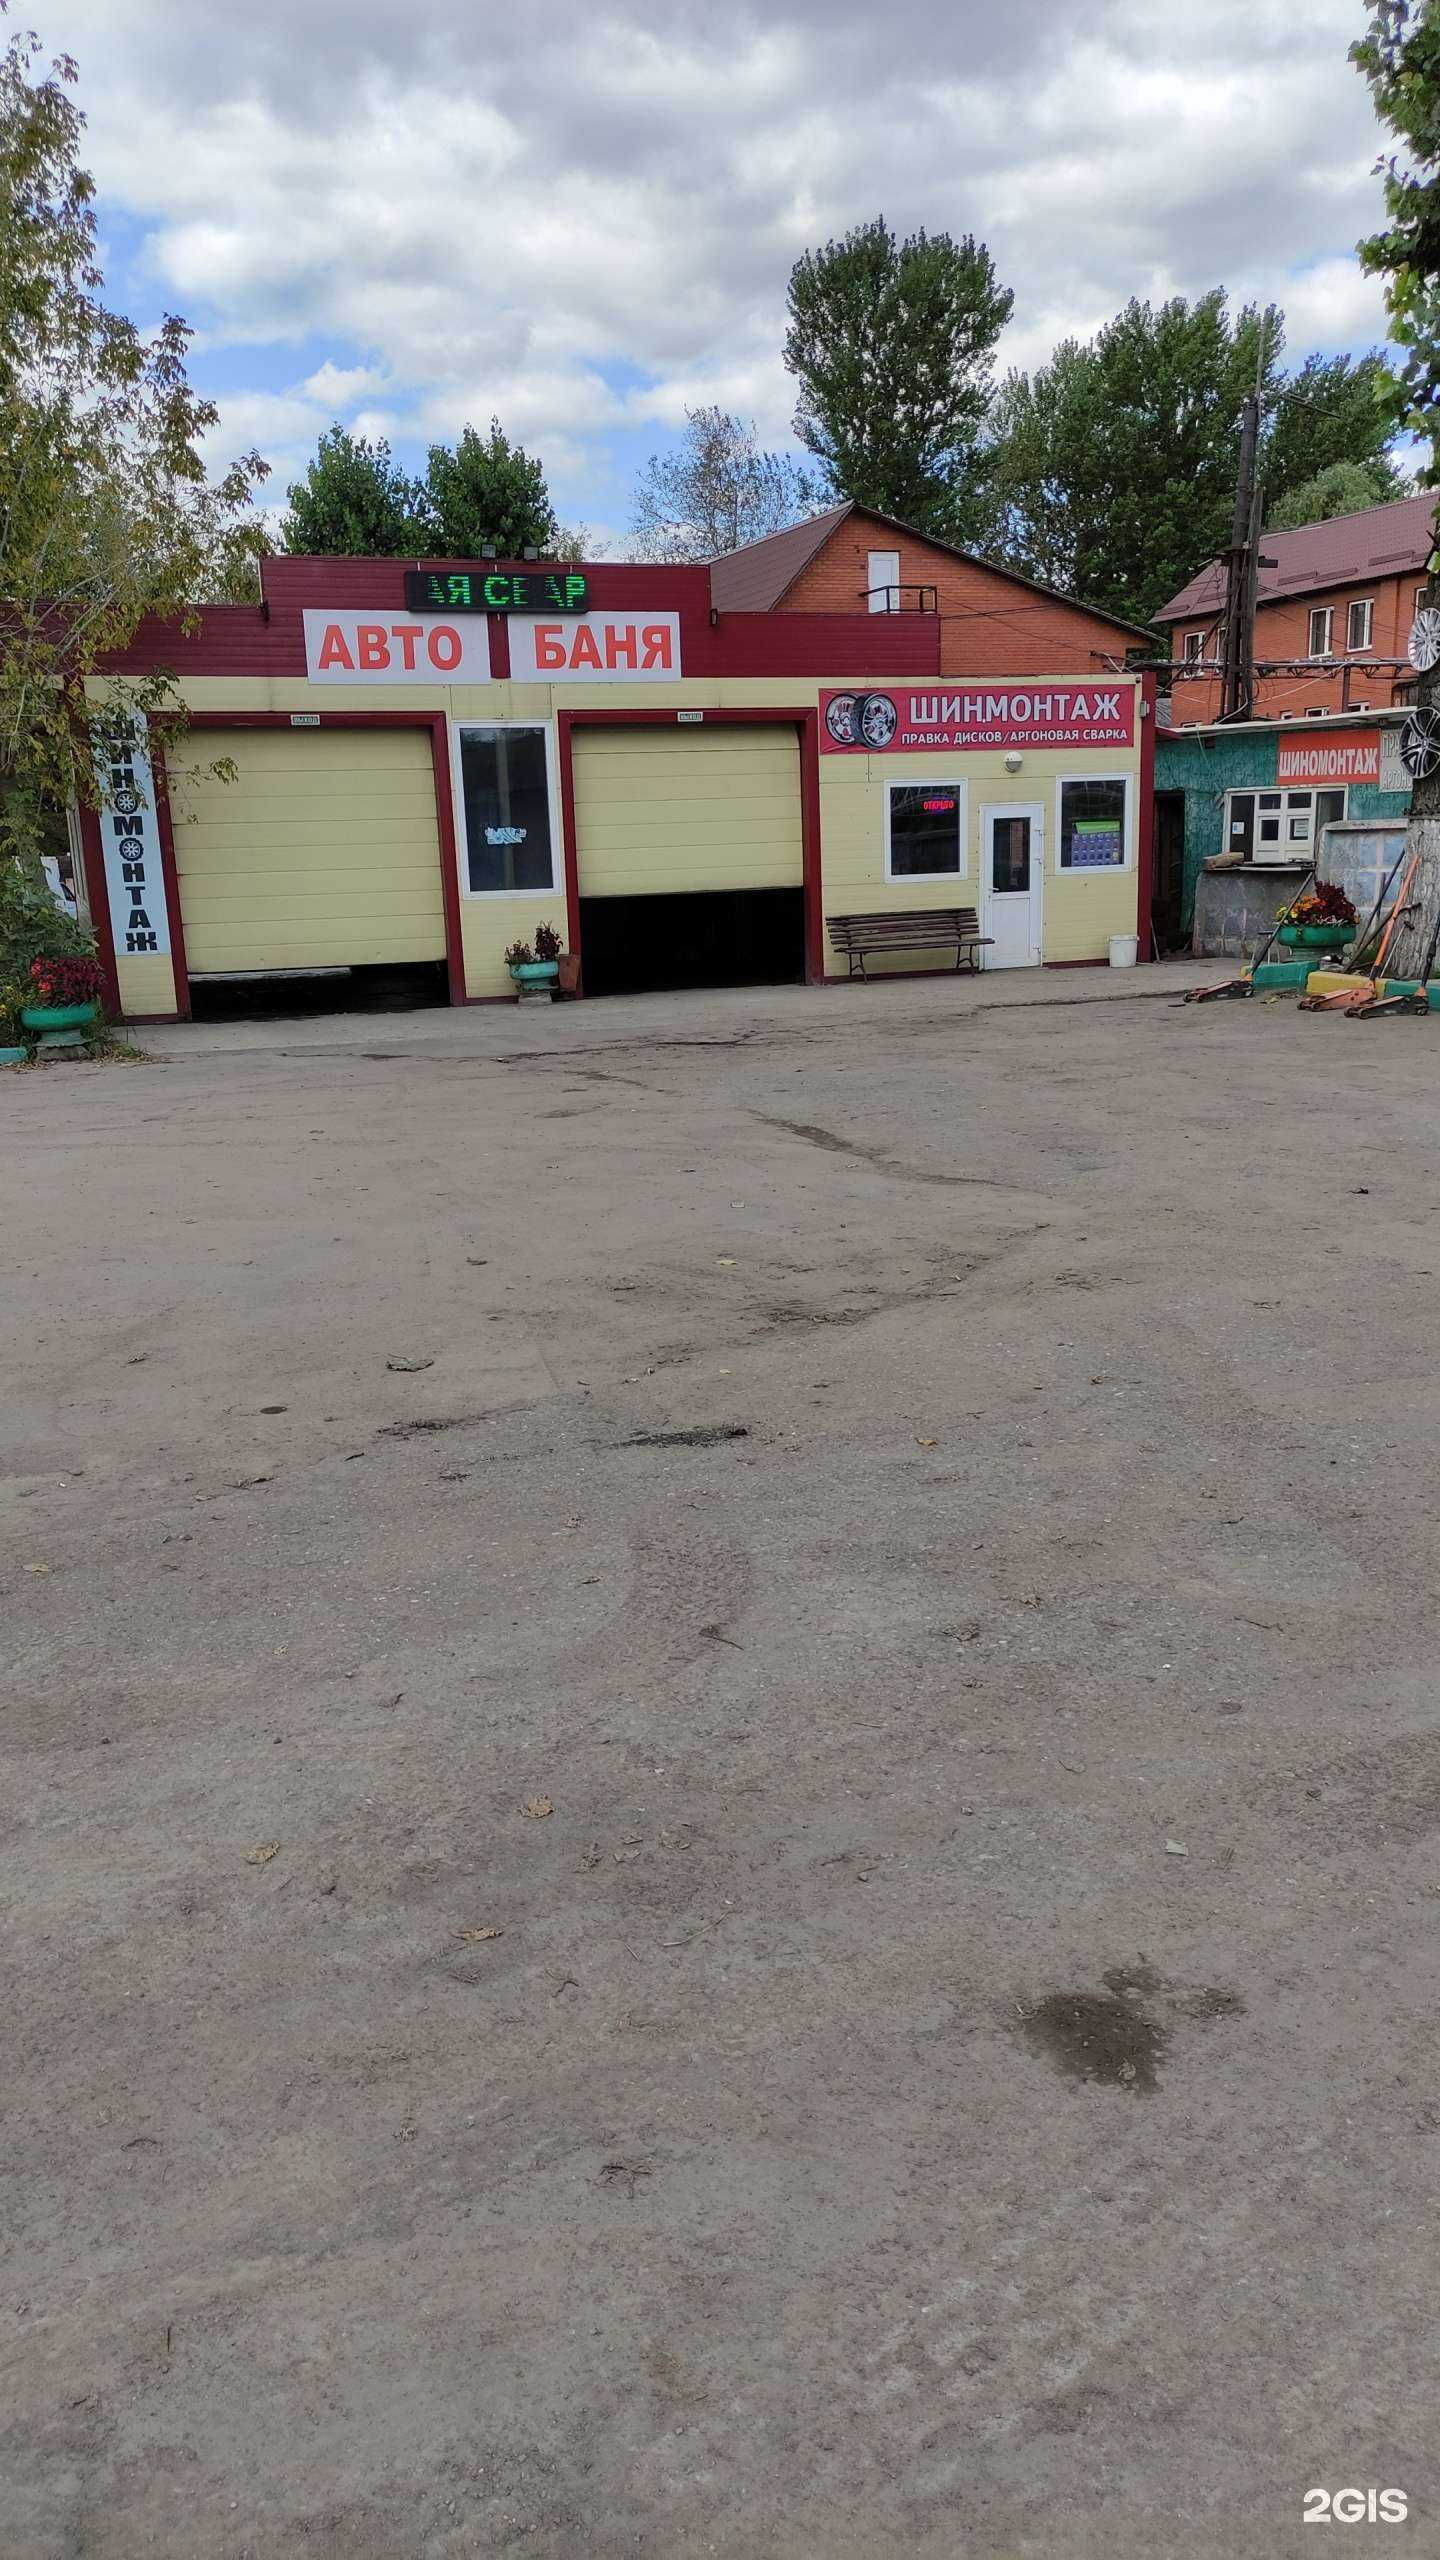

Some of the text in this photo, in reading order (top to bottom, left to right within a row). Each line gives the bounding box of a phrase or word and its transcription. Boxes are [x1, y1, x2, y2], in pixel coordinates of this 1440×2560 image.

[318, 624, 672, 671] АВТО БАНЯ
[901, 732, 950, 745] ПРАВКА
[1083, 729, 1128, 741] СВАРКА
[1279, 748, 1378, 777] ШИНОМОНТАЖ
